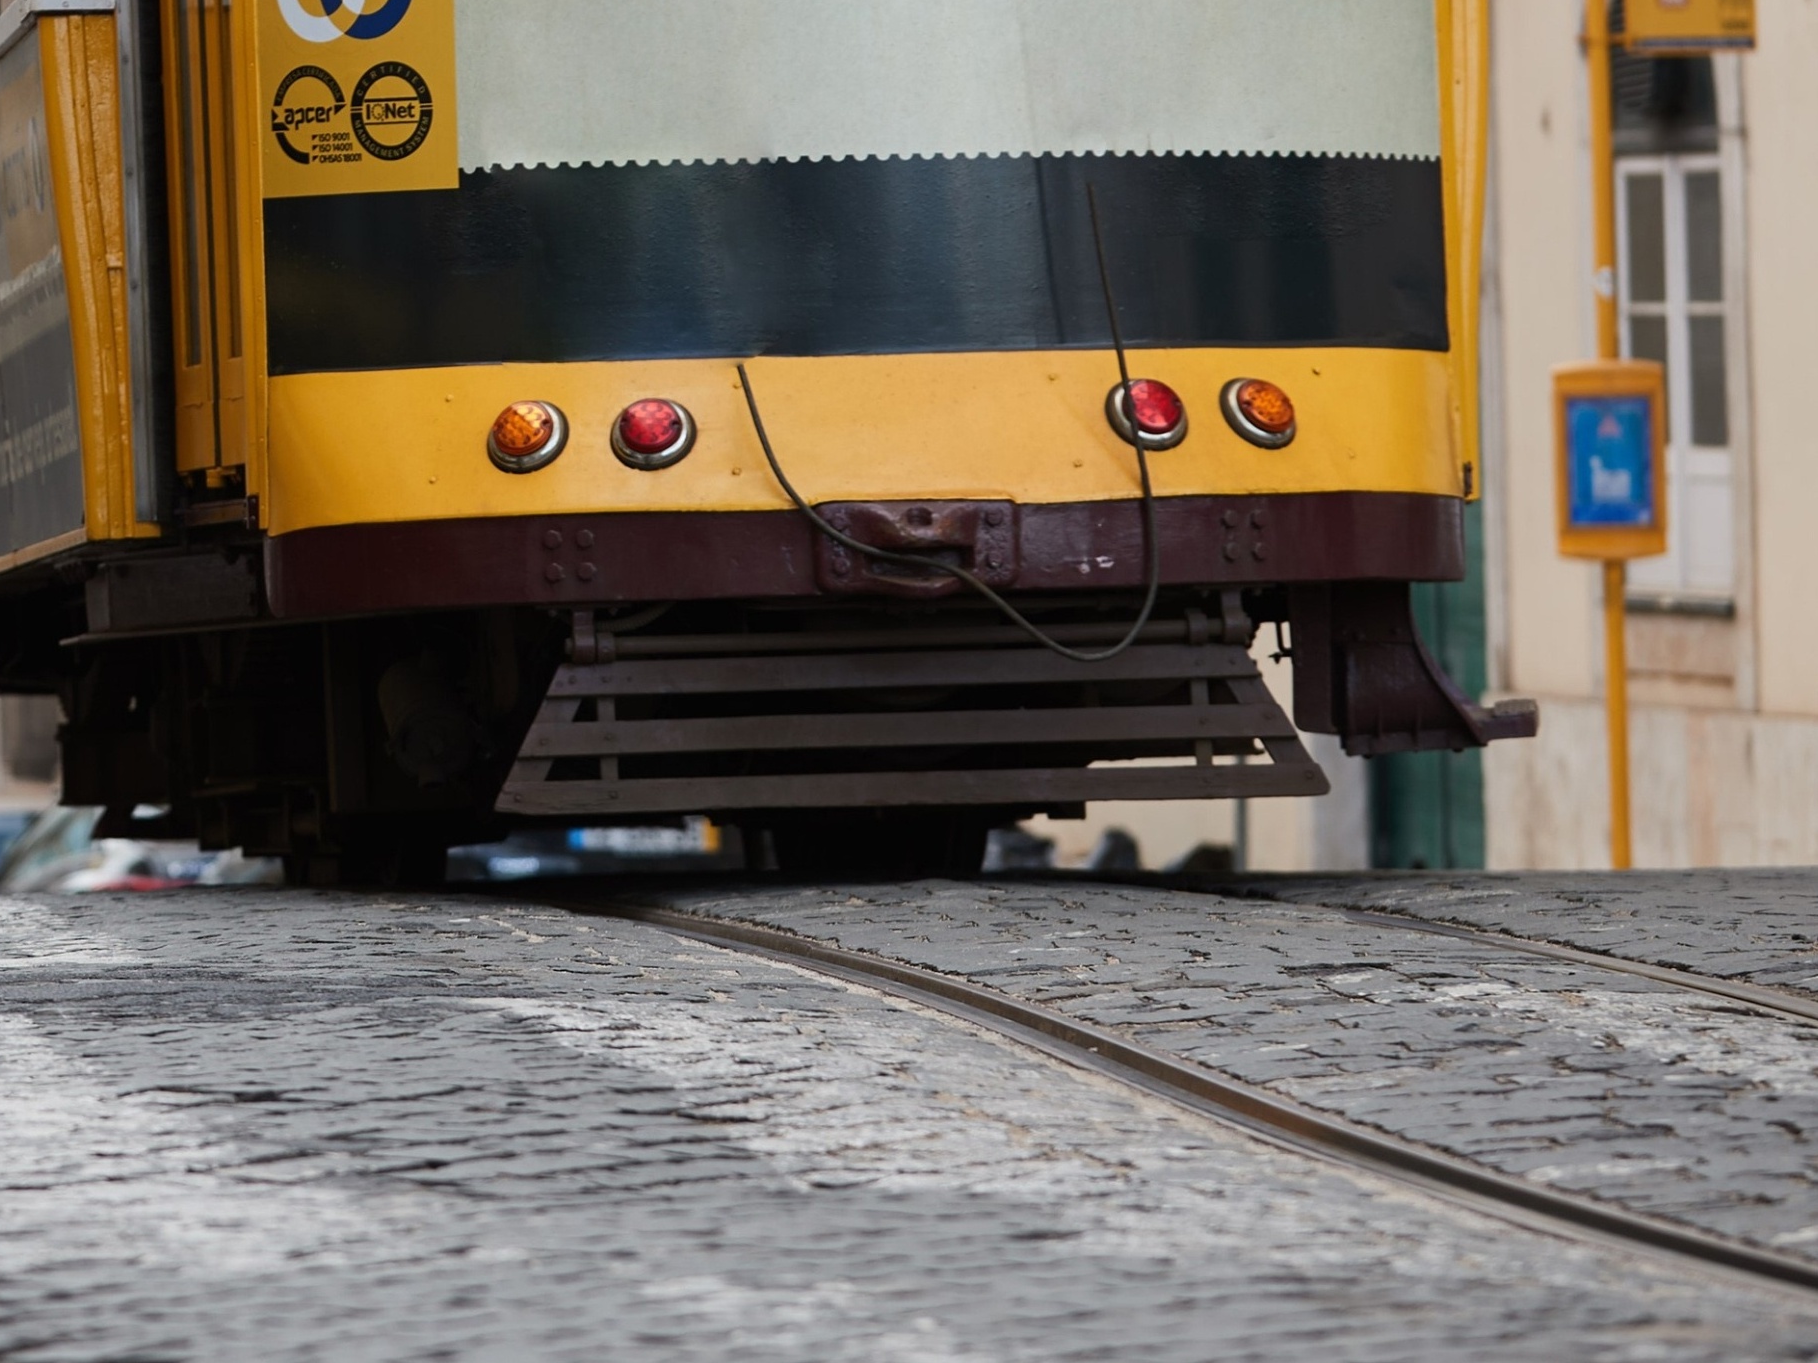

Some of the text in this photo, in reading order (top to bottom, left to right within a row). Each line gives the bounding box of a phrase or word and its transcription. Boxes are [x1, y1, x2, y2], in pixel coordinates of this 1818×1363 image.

[356, 64, 426, 97] CERTIFIED
[283, 106, 333, 130] apcer
[365, 102, 416, 122] IQNet
[332, 132, 350, 141] 9001
[354, 116, 430, 158] MANAGEMENT SYSTEM
